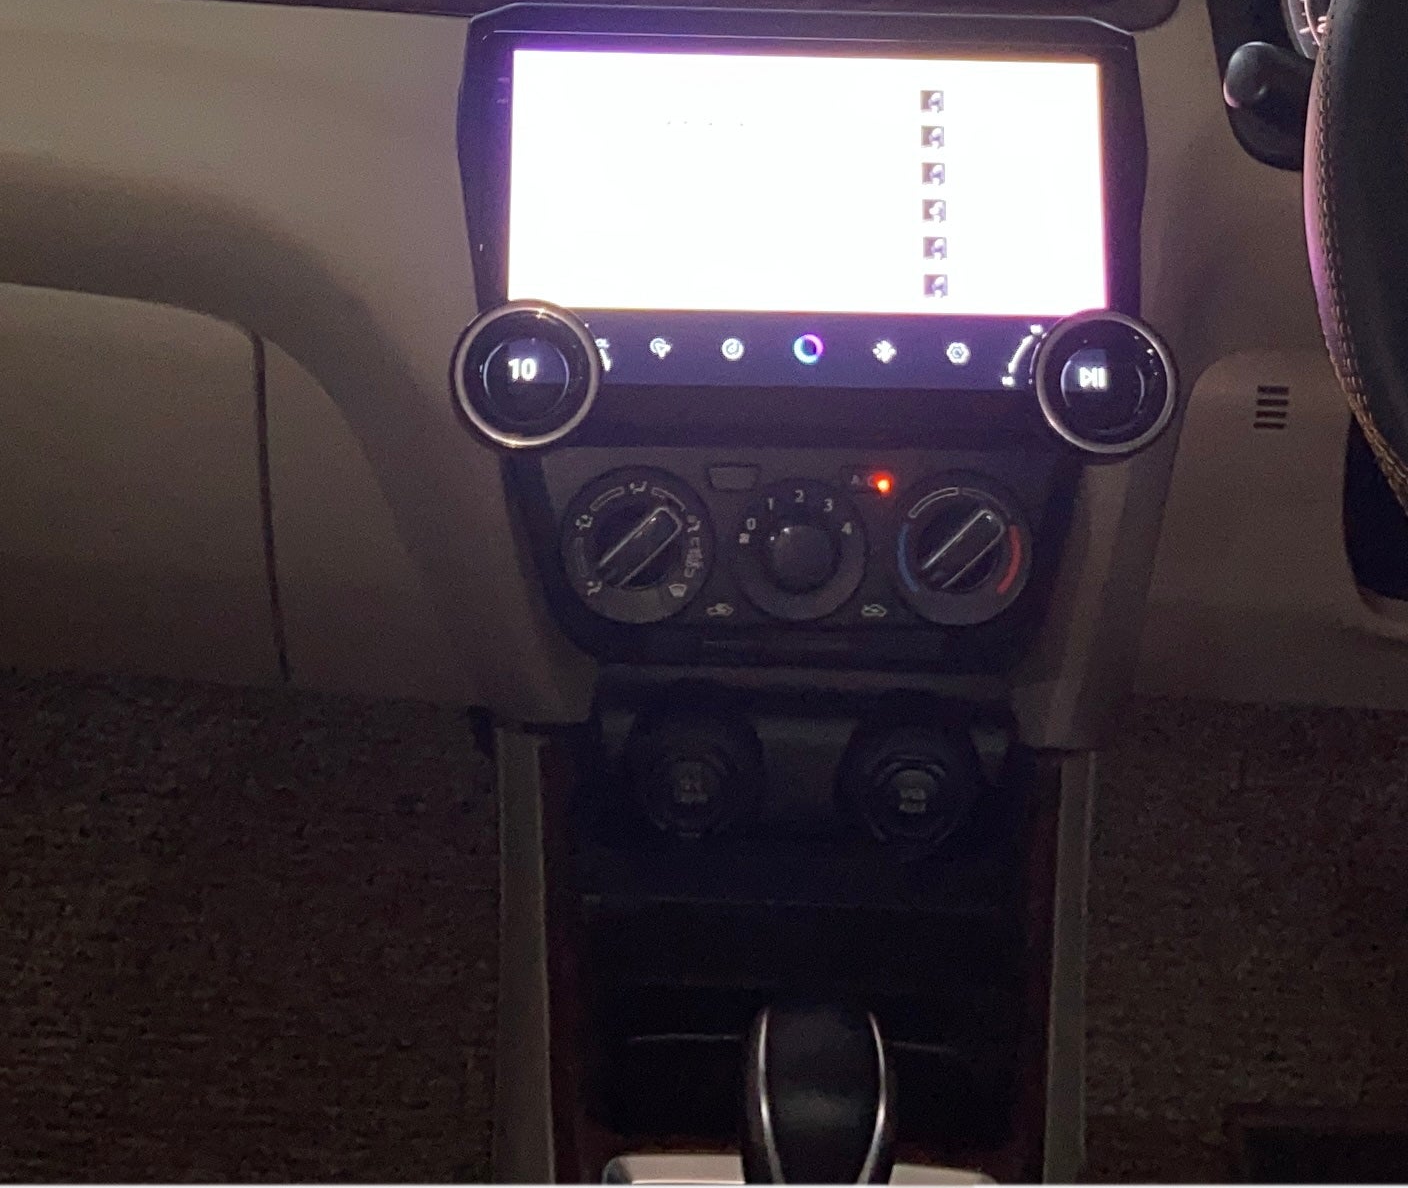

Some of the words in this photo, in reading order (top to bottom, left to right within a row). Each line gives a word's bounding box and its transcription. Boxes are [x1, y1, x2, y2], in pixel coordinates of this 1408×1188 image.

[508, 357, 538, 382] 10
[795, 489, 805, 503] 2
[767, 497, 774, 510] 1
[823, 498, 833, 512] 3
[746, 517, 756, 531] 0
[842, 521, 853, 535] 4
